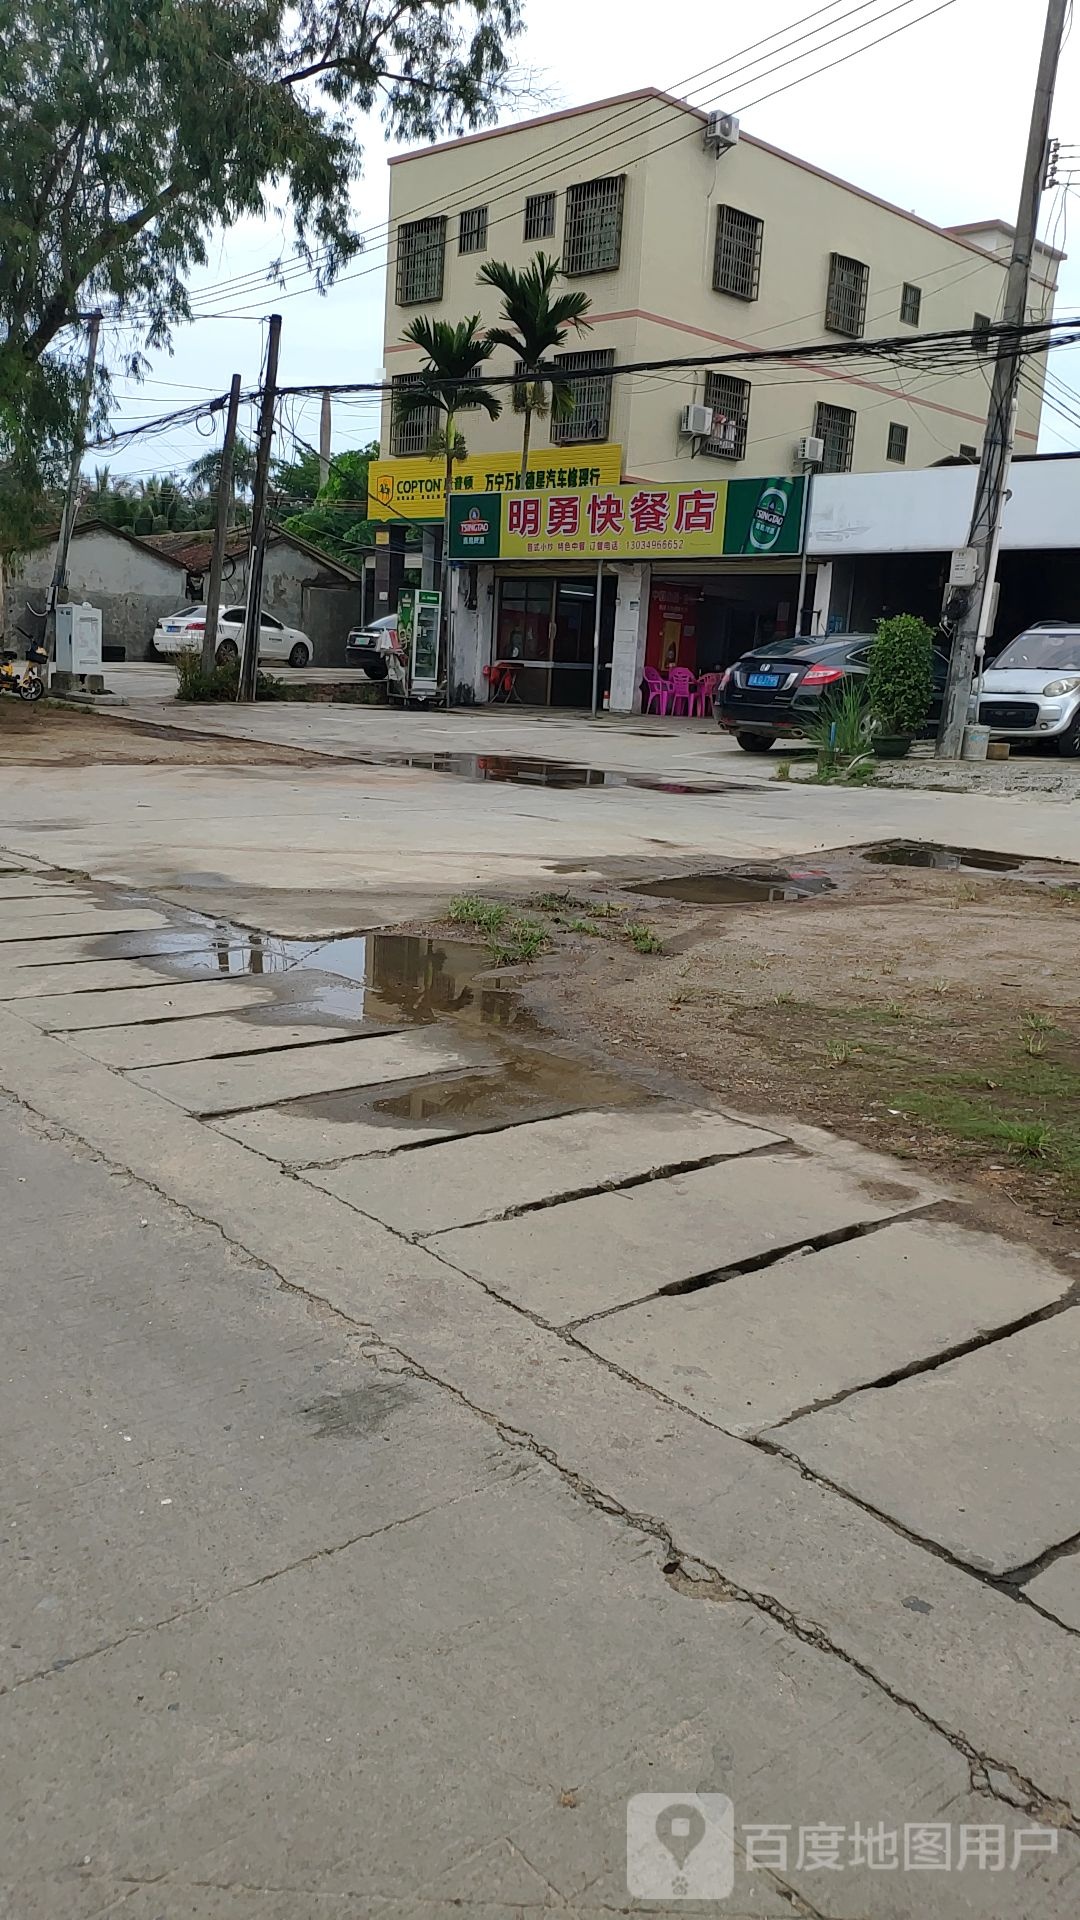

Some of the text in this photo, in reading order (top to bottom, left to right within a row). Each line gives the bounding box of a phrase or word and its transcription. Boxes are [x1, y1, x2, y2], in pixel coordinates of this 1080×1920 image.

[396, 478, 441, 494] COPTON
[507, 489, 719, 538] 明勇快餐店
[755, 509, 784, 526] TSINGTAO
[460, 522, 489, 532] TSINGTAO
